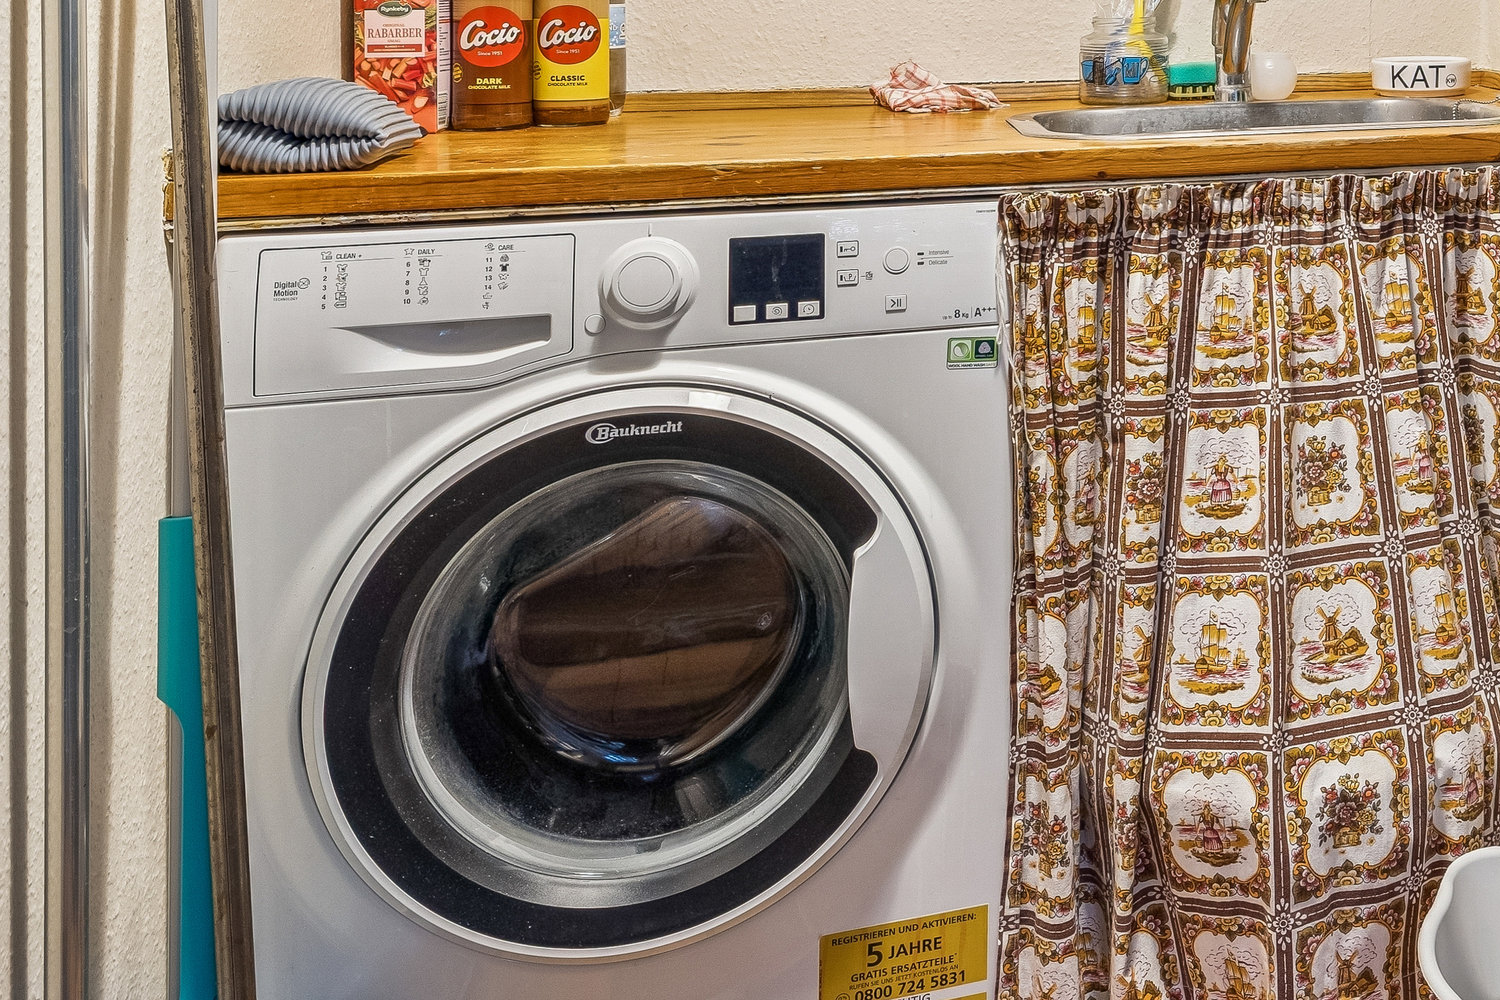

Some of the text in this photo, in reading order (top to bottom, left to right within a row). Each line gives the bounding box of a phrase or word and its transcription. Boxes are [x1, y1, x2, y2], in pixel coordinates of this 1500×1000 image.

[368, 28, 422, 39] RABARBER
[460, 20, 520, 50] Cocio
[540, 19, 597, 48] Cocio
[1391, 65, 1446, 89] KAT
[273, 281, 298, 290] Digital
[273, 290, 299, 298] Motion
[954, 309, 961, 319] 8
[592, 421, 683, 441] Bauknecht
[831, 913, 977, 947] REGISTRIEREN UND AKTIVIEREN:
[867, 936, 943, 968] 5 JAHRE
[849, 982, 870, 991] RUFEN
[895, 973, 912, 983] JETZT
[913, 966, 948, 978] KOSTENLOS
[949, 963, 959, 971] AN
[850, 968, 888, 983] GRATIS
[854, 969, 966, 1000] 0800 724 5831
